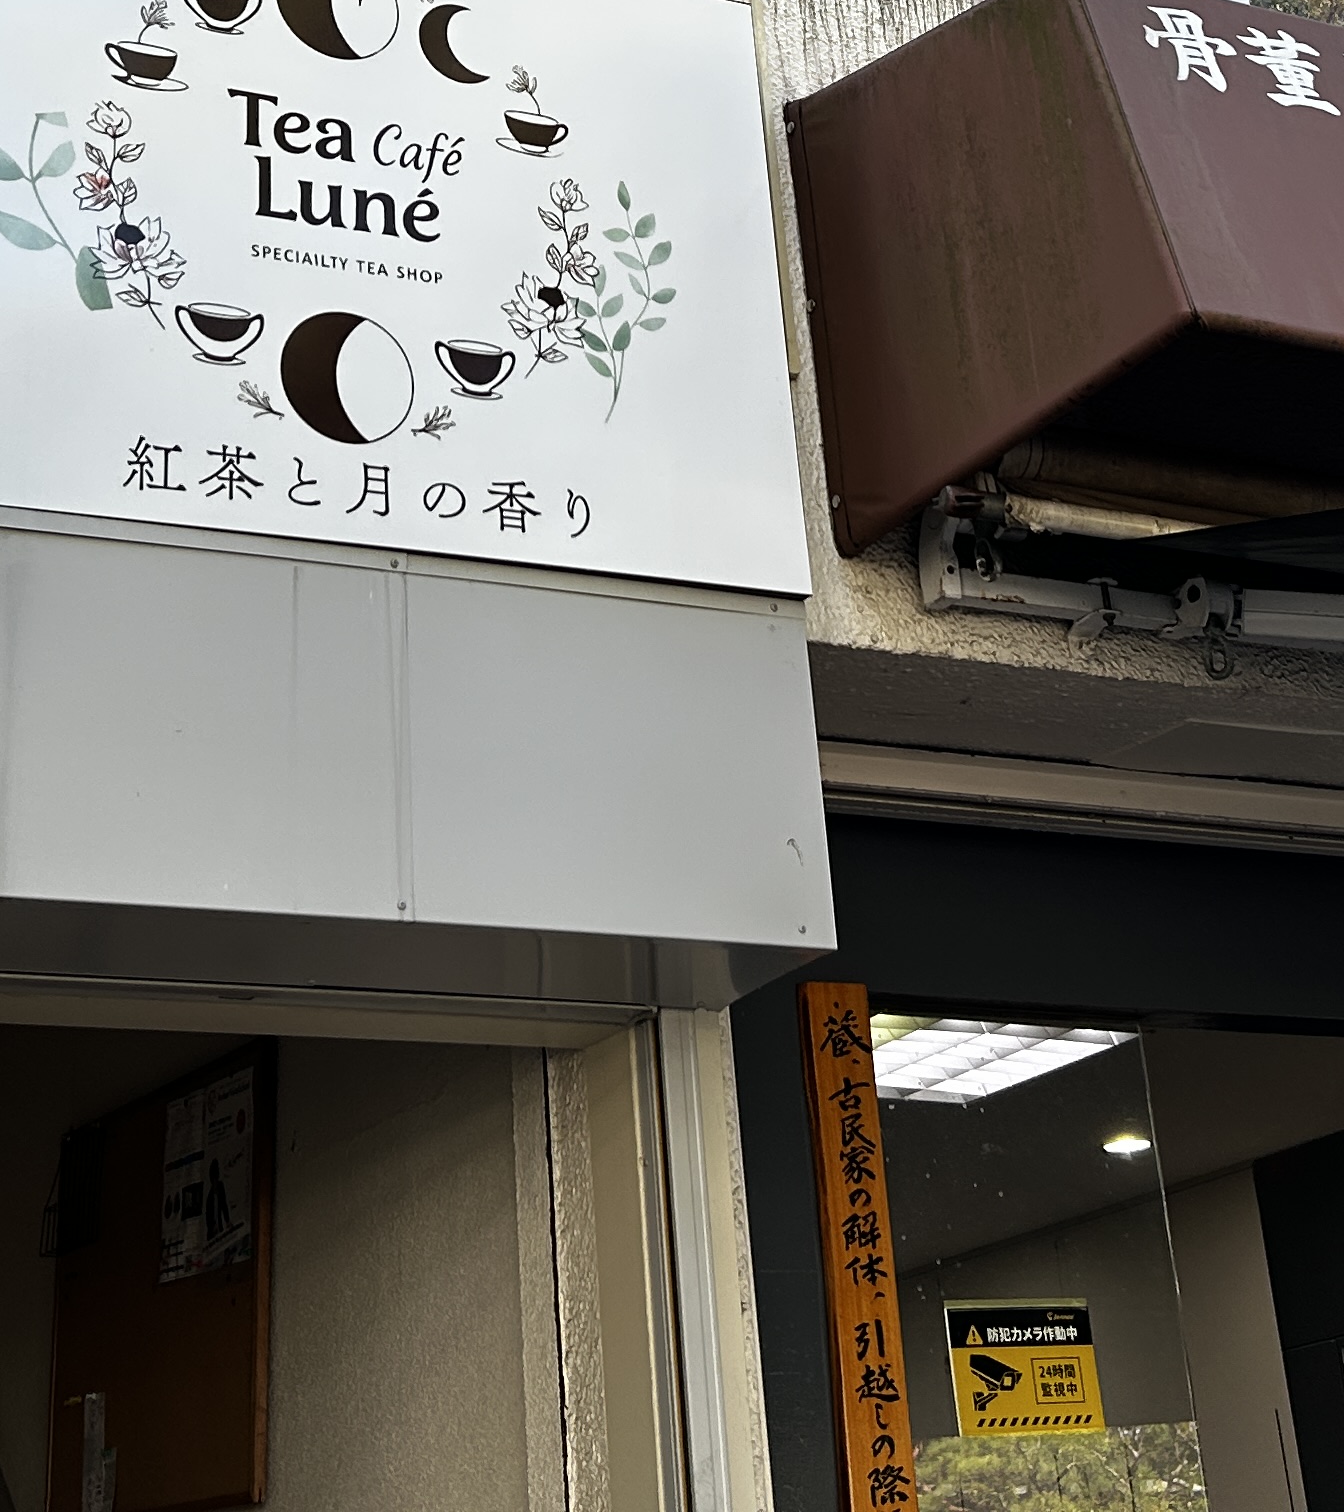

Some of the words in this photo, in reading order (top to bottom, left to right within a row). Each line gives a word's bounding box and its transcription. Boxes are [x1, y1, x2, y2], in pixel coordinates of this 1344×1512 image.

[227, 87, 356, 162] Tea
[372, 123, 466, 184] Café
[253, 154, 442, 243] Luné
[250, 243, 349, 271] SPECIAILTY
[355, 259, 389, 277] TEA
[396, 265, 443, 285] SHOP
[122, 434, 592, 539] 紅茶と月の香り
[986, 1325, 1078, 1344] 防犯カメラ作動中
[1038, 1364, 1077, 1380] 24時間
[1040, 1381, 1078, 1398] 監視中
